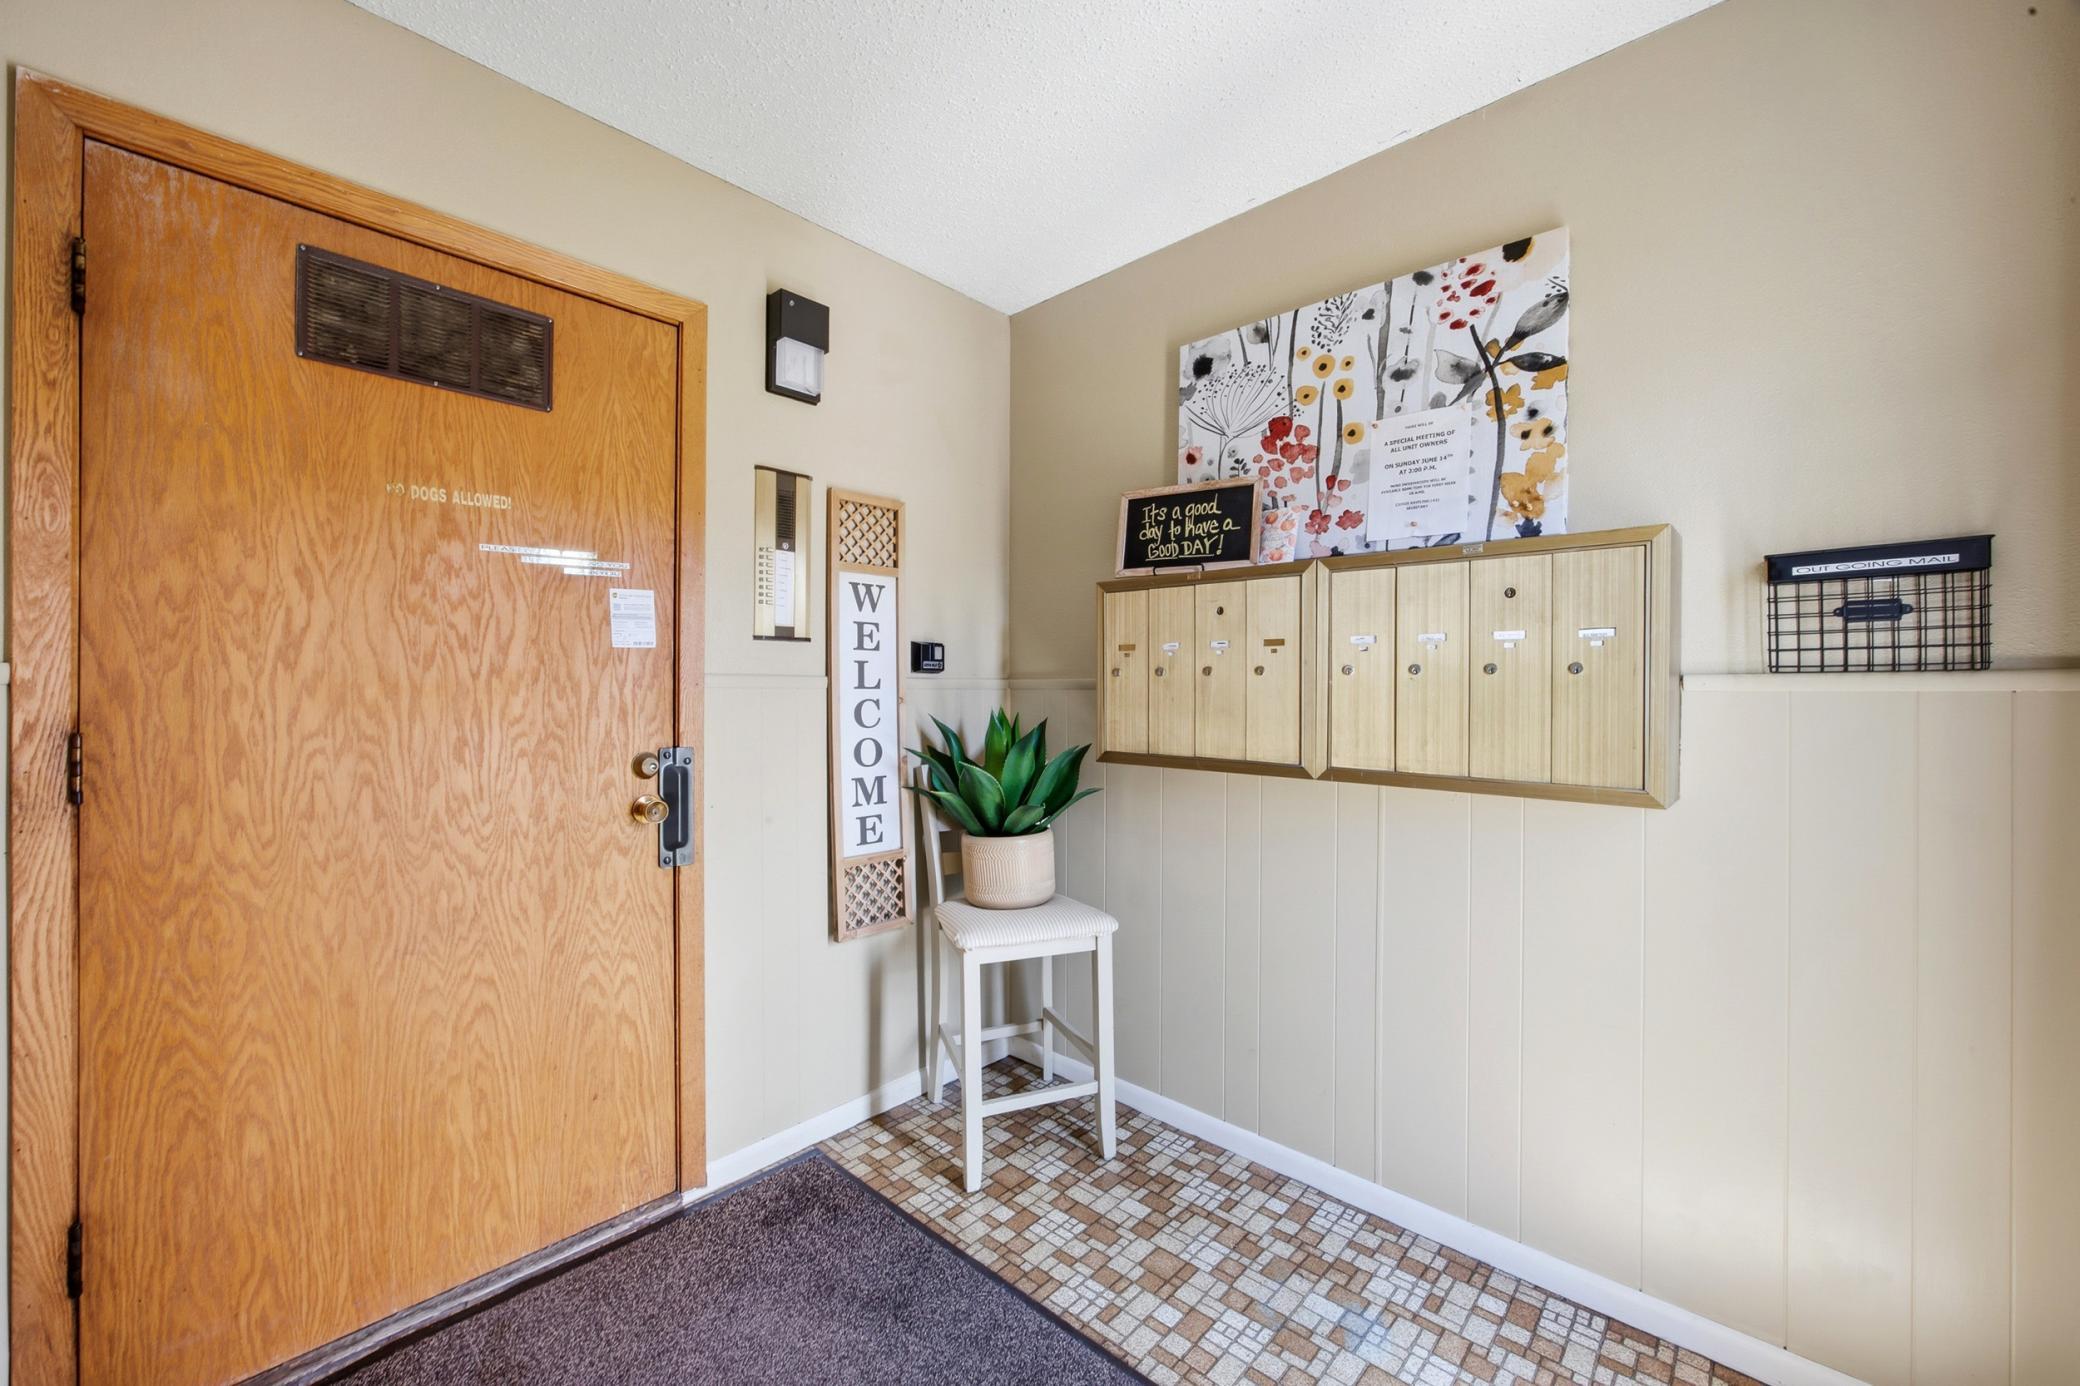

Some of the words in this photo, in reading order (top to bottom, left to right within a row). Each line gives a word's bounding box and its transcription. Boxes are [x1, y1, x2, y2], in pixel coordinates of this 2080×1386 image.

[1389, 437, 1414, 446] SPECIAL
[1416, 431, 1445, 440] MEETING
[1402, 443, 1418, 451] UNIT
[1419, 438, 1448, 448] OWNERS
[1395, 459, 1420, 468] SUNDAY
[1421, 456, 1438, 464] JUNE
[410, 485, 447, 502] DOGS
[452, 491, 512, 510] ALLOWED!
[1172, 506, 1182, 520] a
[1185, 493, 1222, 526] good
[1139, 522, 1163, 547] day
[1168, 520, 1181, 540] to
[1185, 517, 1219, 538] have
[1222, 518, 1240, 531] a
[1148, 542, 1179, 559] GOOD
[1181, 534, 1224, 556] DAY!
[1796, 566, 1828, 574] OUT
[1835, 559, 1902, 571] GOING
[1908, 555, 1958, 565] MAIL
[848, 581, 888, 846] WELCOME
